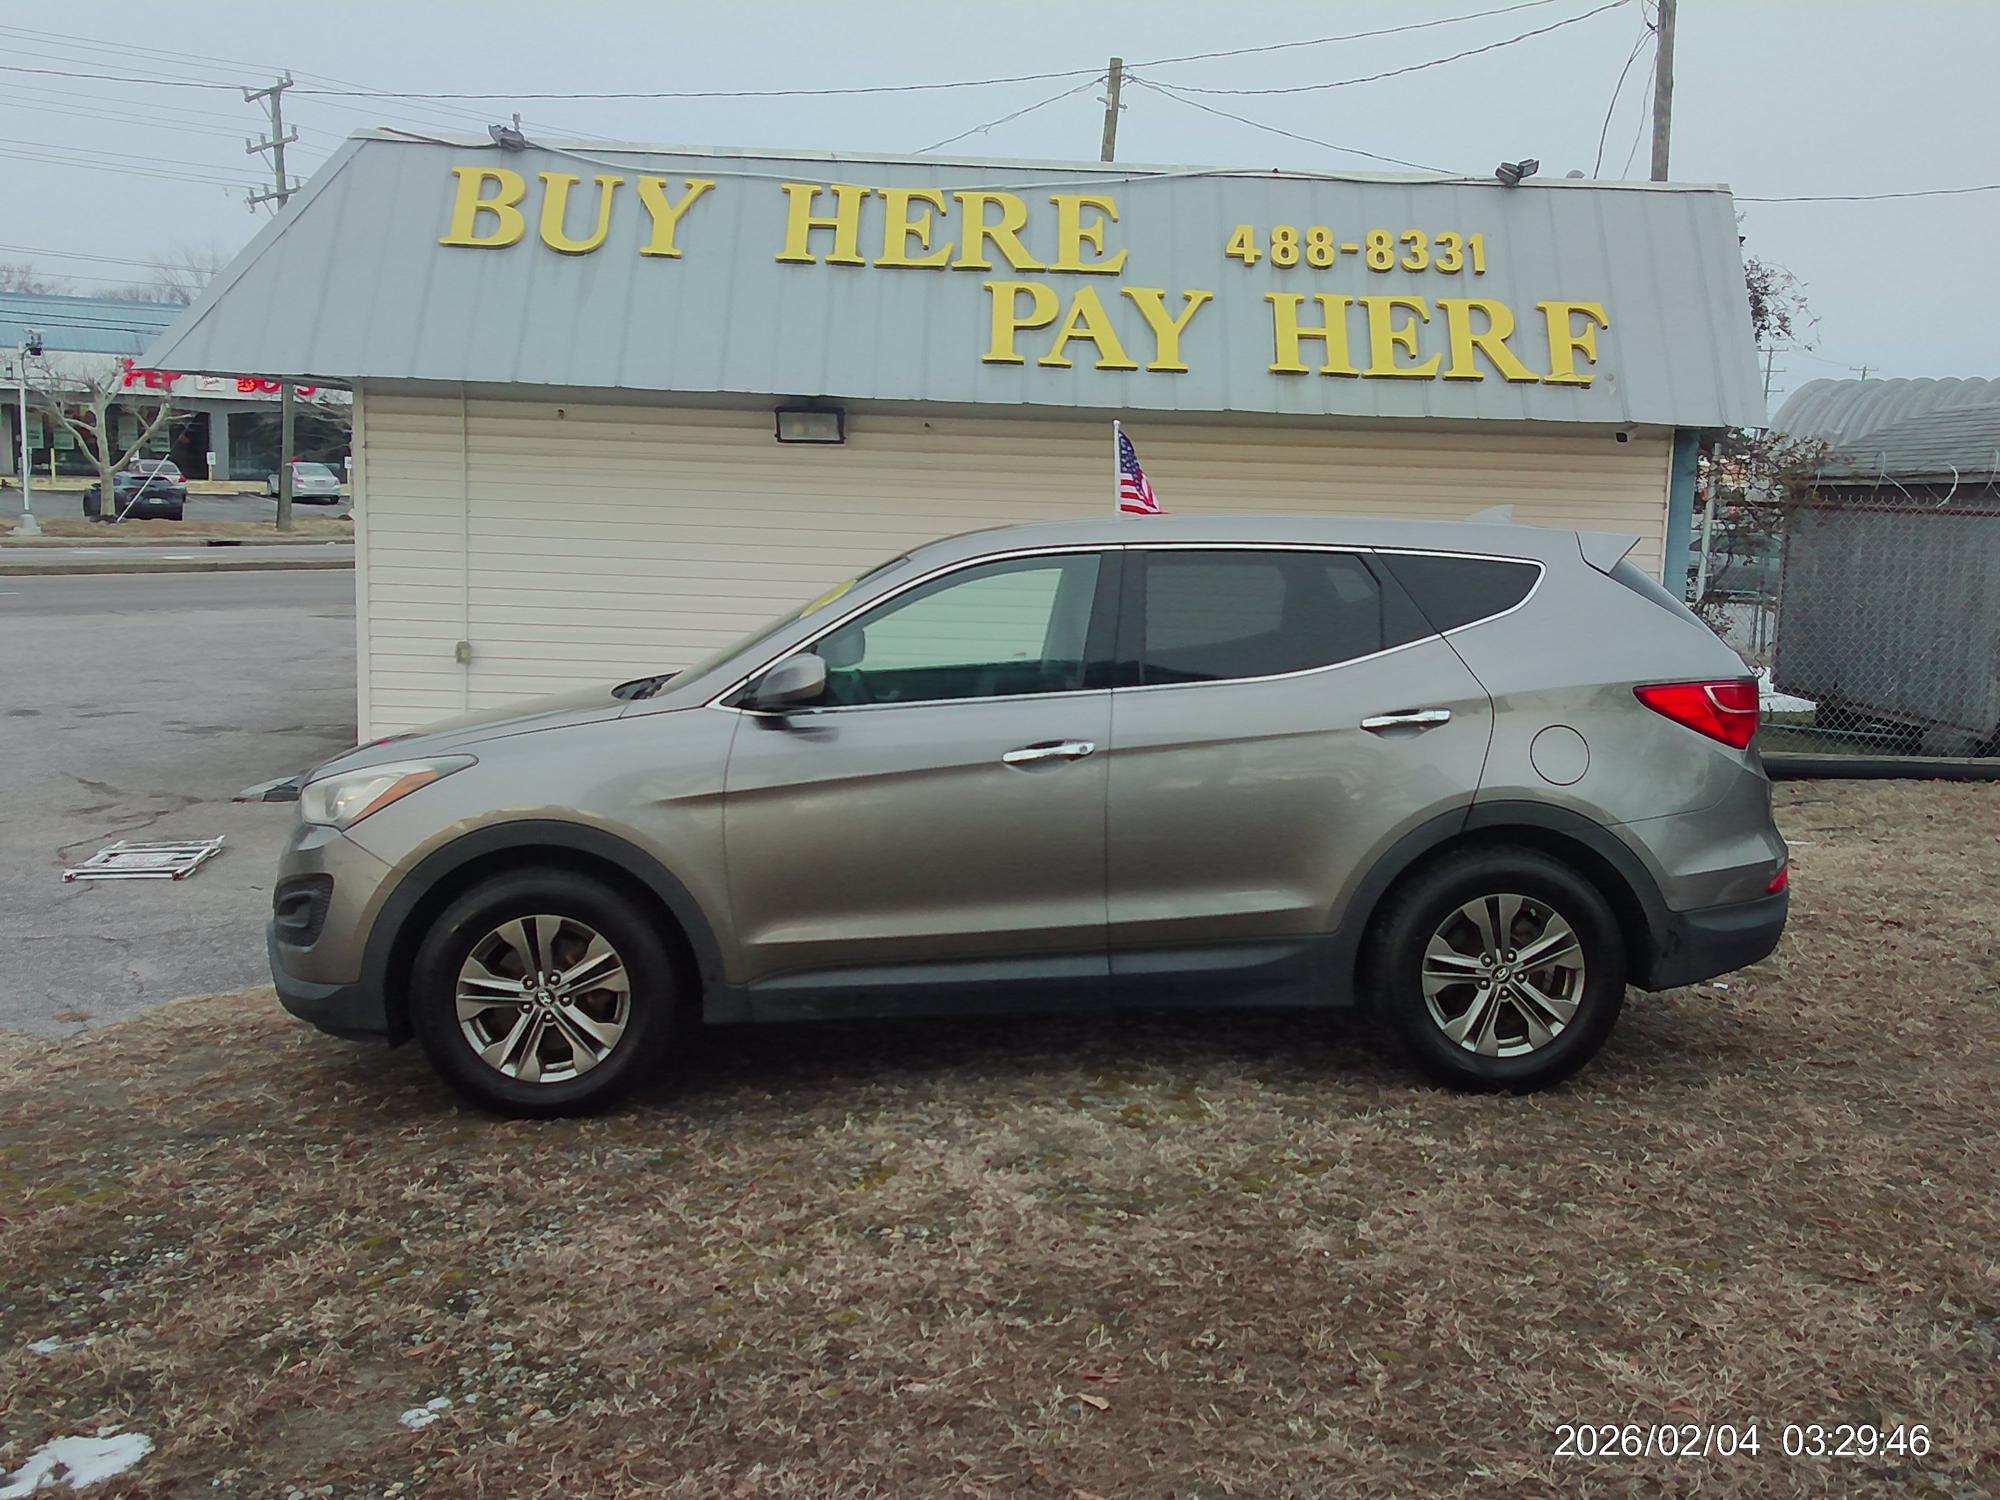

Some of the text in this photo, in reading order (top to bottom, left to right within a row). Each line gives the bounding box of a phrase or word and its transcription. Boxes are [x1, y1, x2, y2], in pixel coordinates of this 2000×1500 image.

[439, 165, 1129, 276] BUY HERE
[1225, 223, 1486, 276] 488-8331
[981, 280, 1213, 374] PAY
